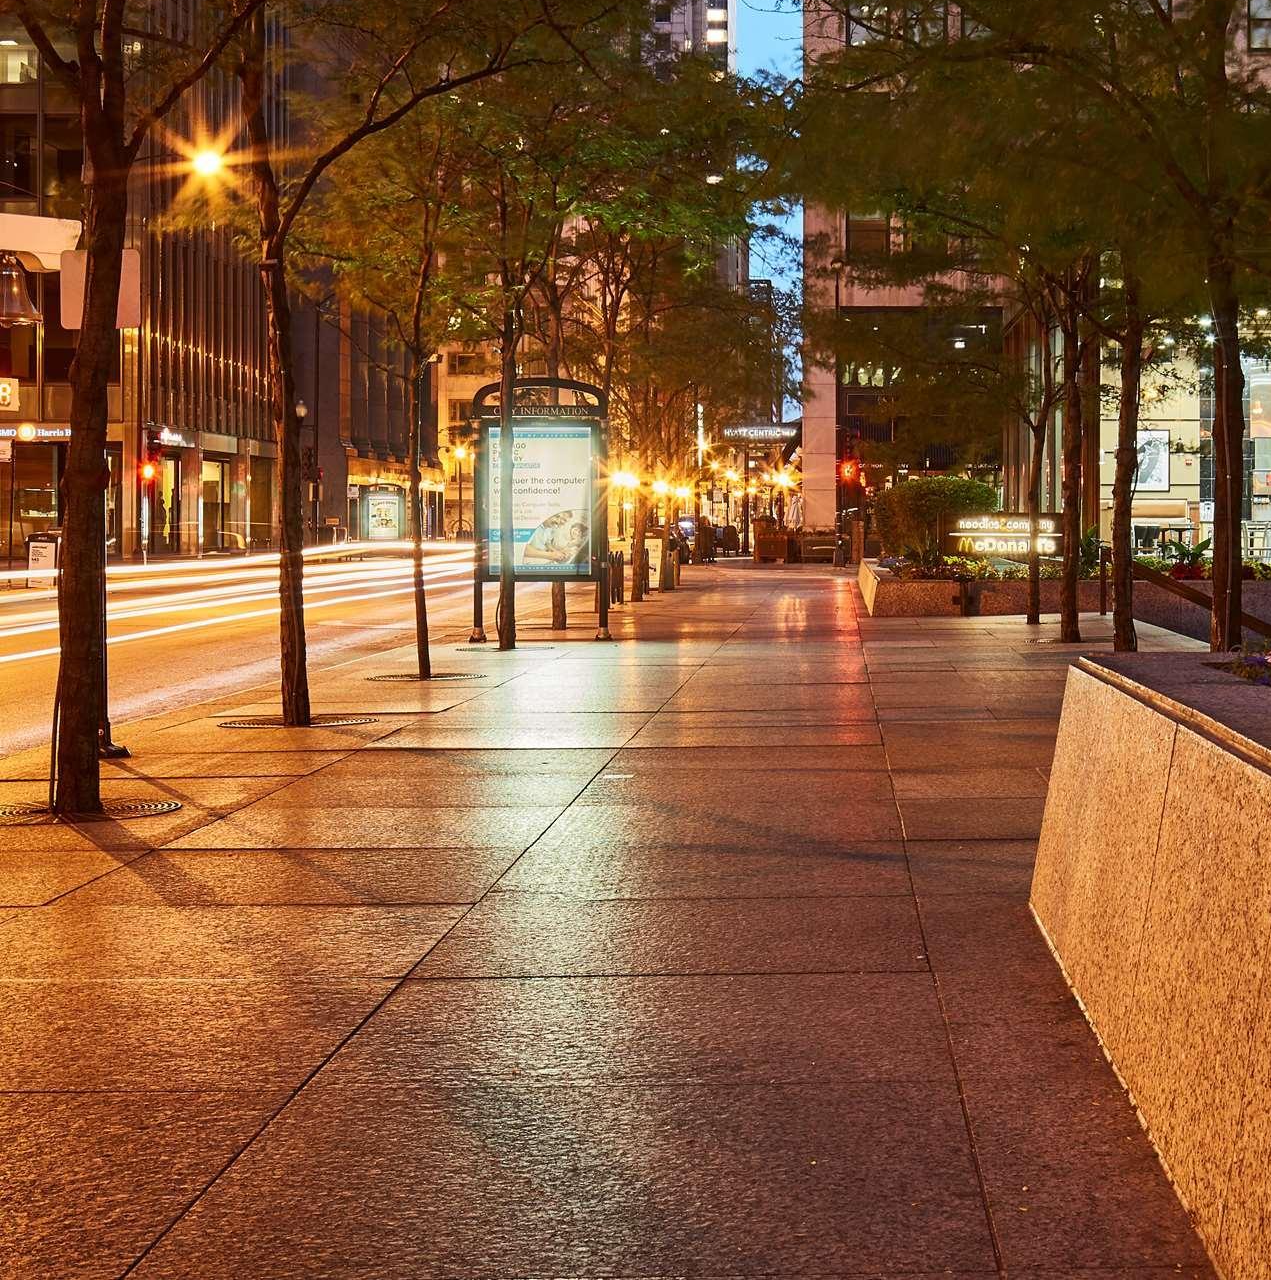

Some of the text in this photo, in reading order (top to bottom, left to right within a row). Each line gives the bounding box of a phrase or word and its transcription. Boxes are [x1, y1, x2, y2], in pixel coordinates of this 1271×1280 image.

[493, 406, 590, 416] CY INFORMATION
[37, 428, 64, 437] Harris
[724, 428, 748, 437] HYATT
[748, 428, 781, 438] CENTRIC
[493, 475, 586, 487] Cuer the computer
[513, 486, 561, 495] confidence!
[959, 537, 1056, 554] McDonal's
